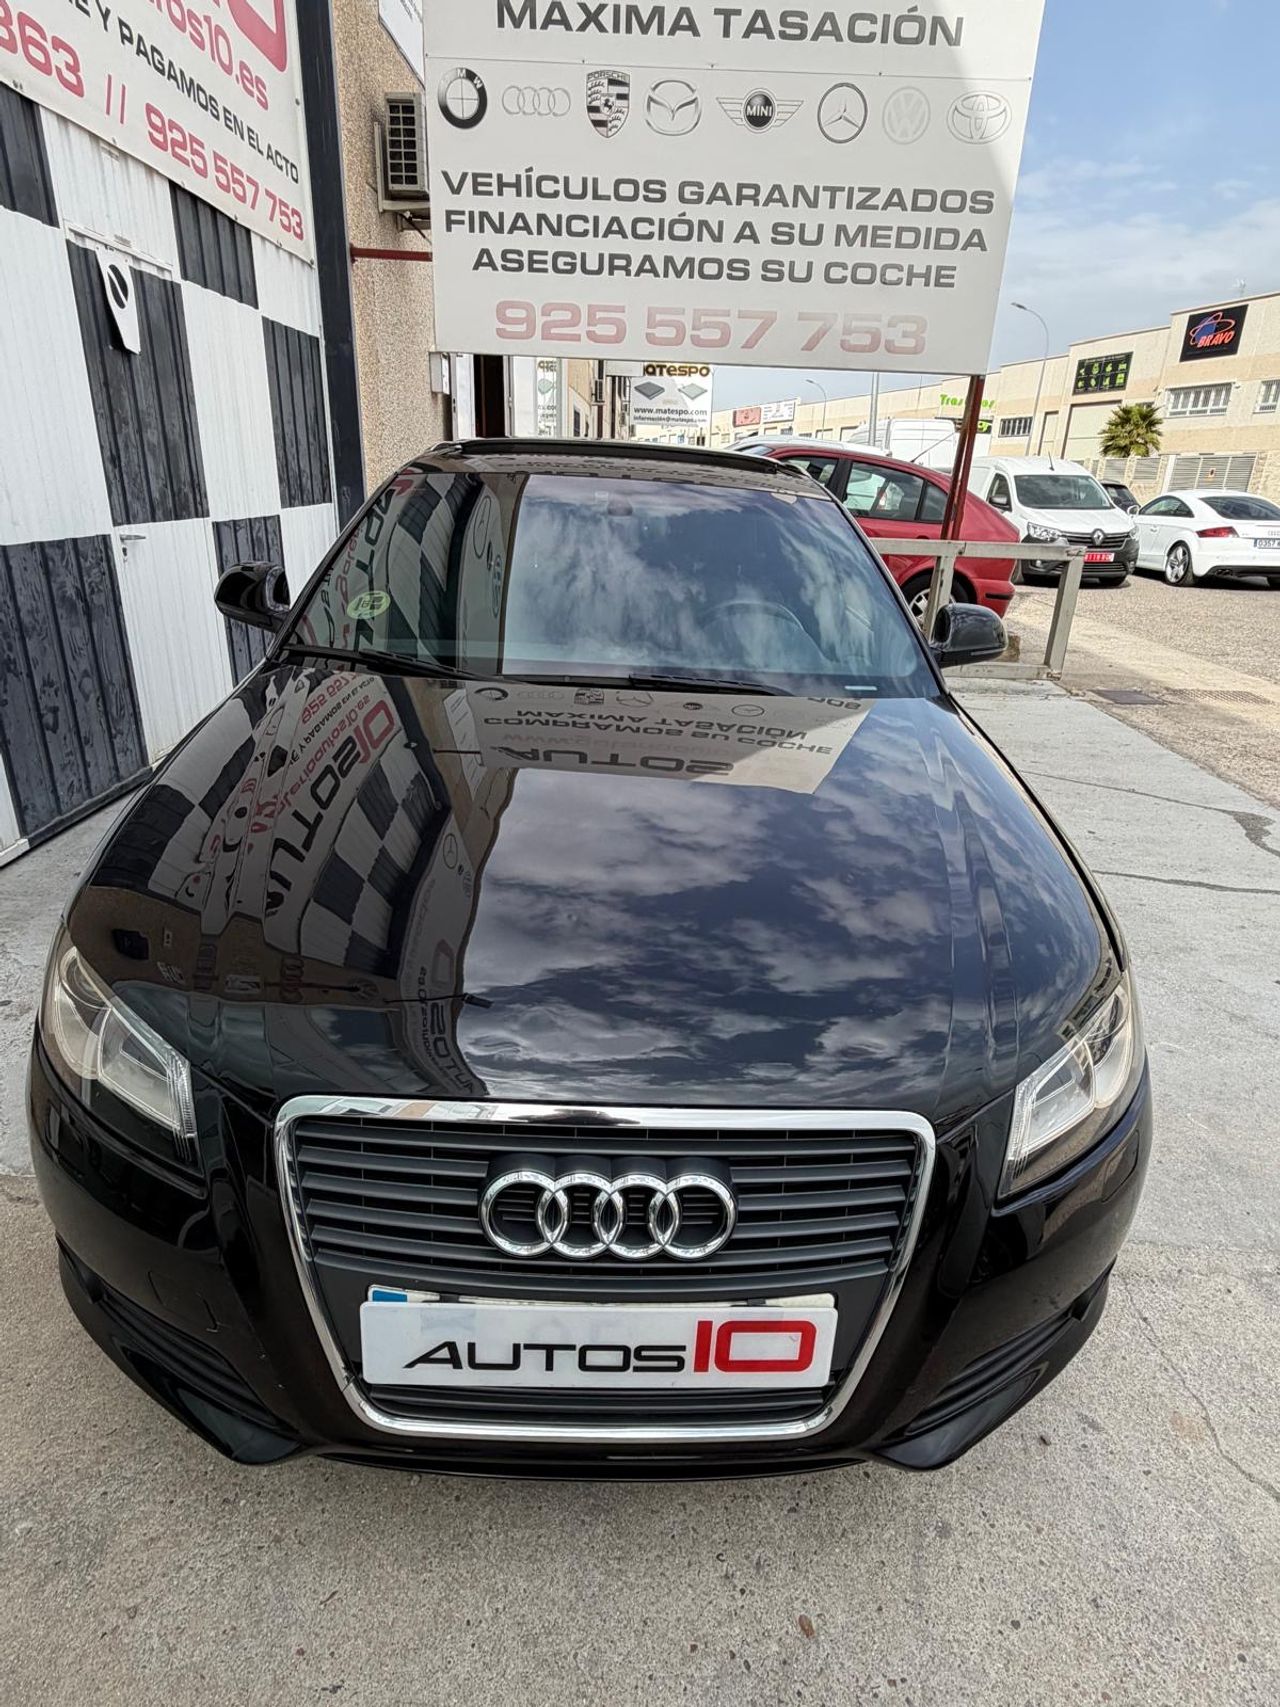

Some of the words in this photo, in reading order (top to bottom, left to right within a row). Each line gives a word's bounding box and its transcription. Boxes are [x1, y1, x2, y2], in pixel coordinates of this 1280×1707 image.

[496, 0, 701, 38] MAXIMA
[714, 5, 964, 47] TASACIÓN
[118, 16, 220, 121] PAGAMOS
[223, 105, 245, 141] EN
[247, 125, 264, 156] EL
[266, 143, 299, 184] ACTO
[746, 105, 772, 117] MINI
[145, 102, 208, 179] 925
[213, 149, 260, 210] 557
[265, 188, 304, 241] 753
[441, 166, 667, 203] VEHÍCULOS
[678, 180, 995, 214] GARANTIZADOS
[445, 209, 724, 243] FINANCIACIÓN
[733, 220, 760, 245] A
[771, 222, 824, 246] SU
[834, 224, 988, 251] MEDIDA
[472, 248, 750, 281] ASEGURAMOS
[761, 259, 813, 283] SU
[824, 261, 957, 288] COCHE
[495, 300, 627, 344] 925
[645, 306, 778, 350] 557
[798, 311, 928, 355] 753
[1197, 330, 1236, 348] BRAVO
